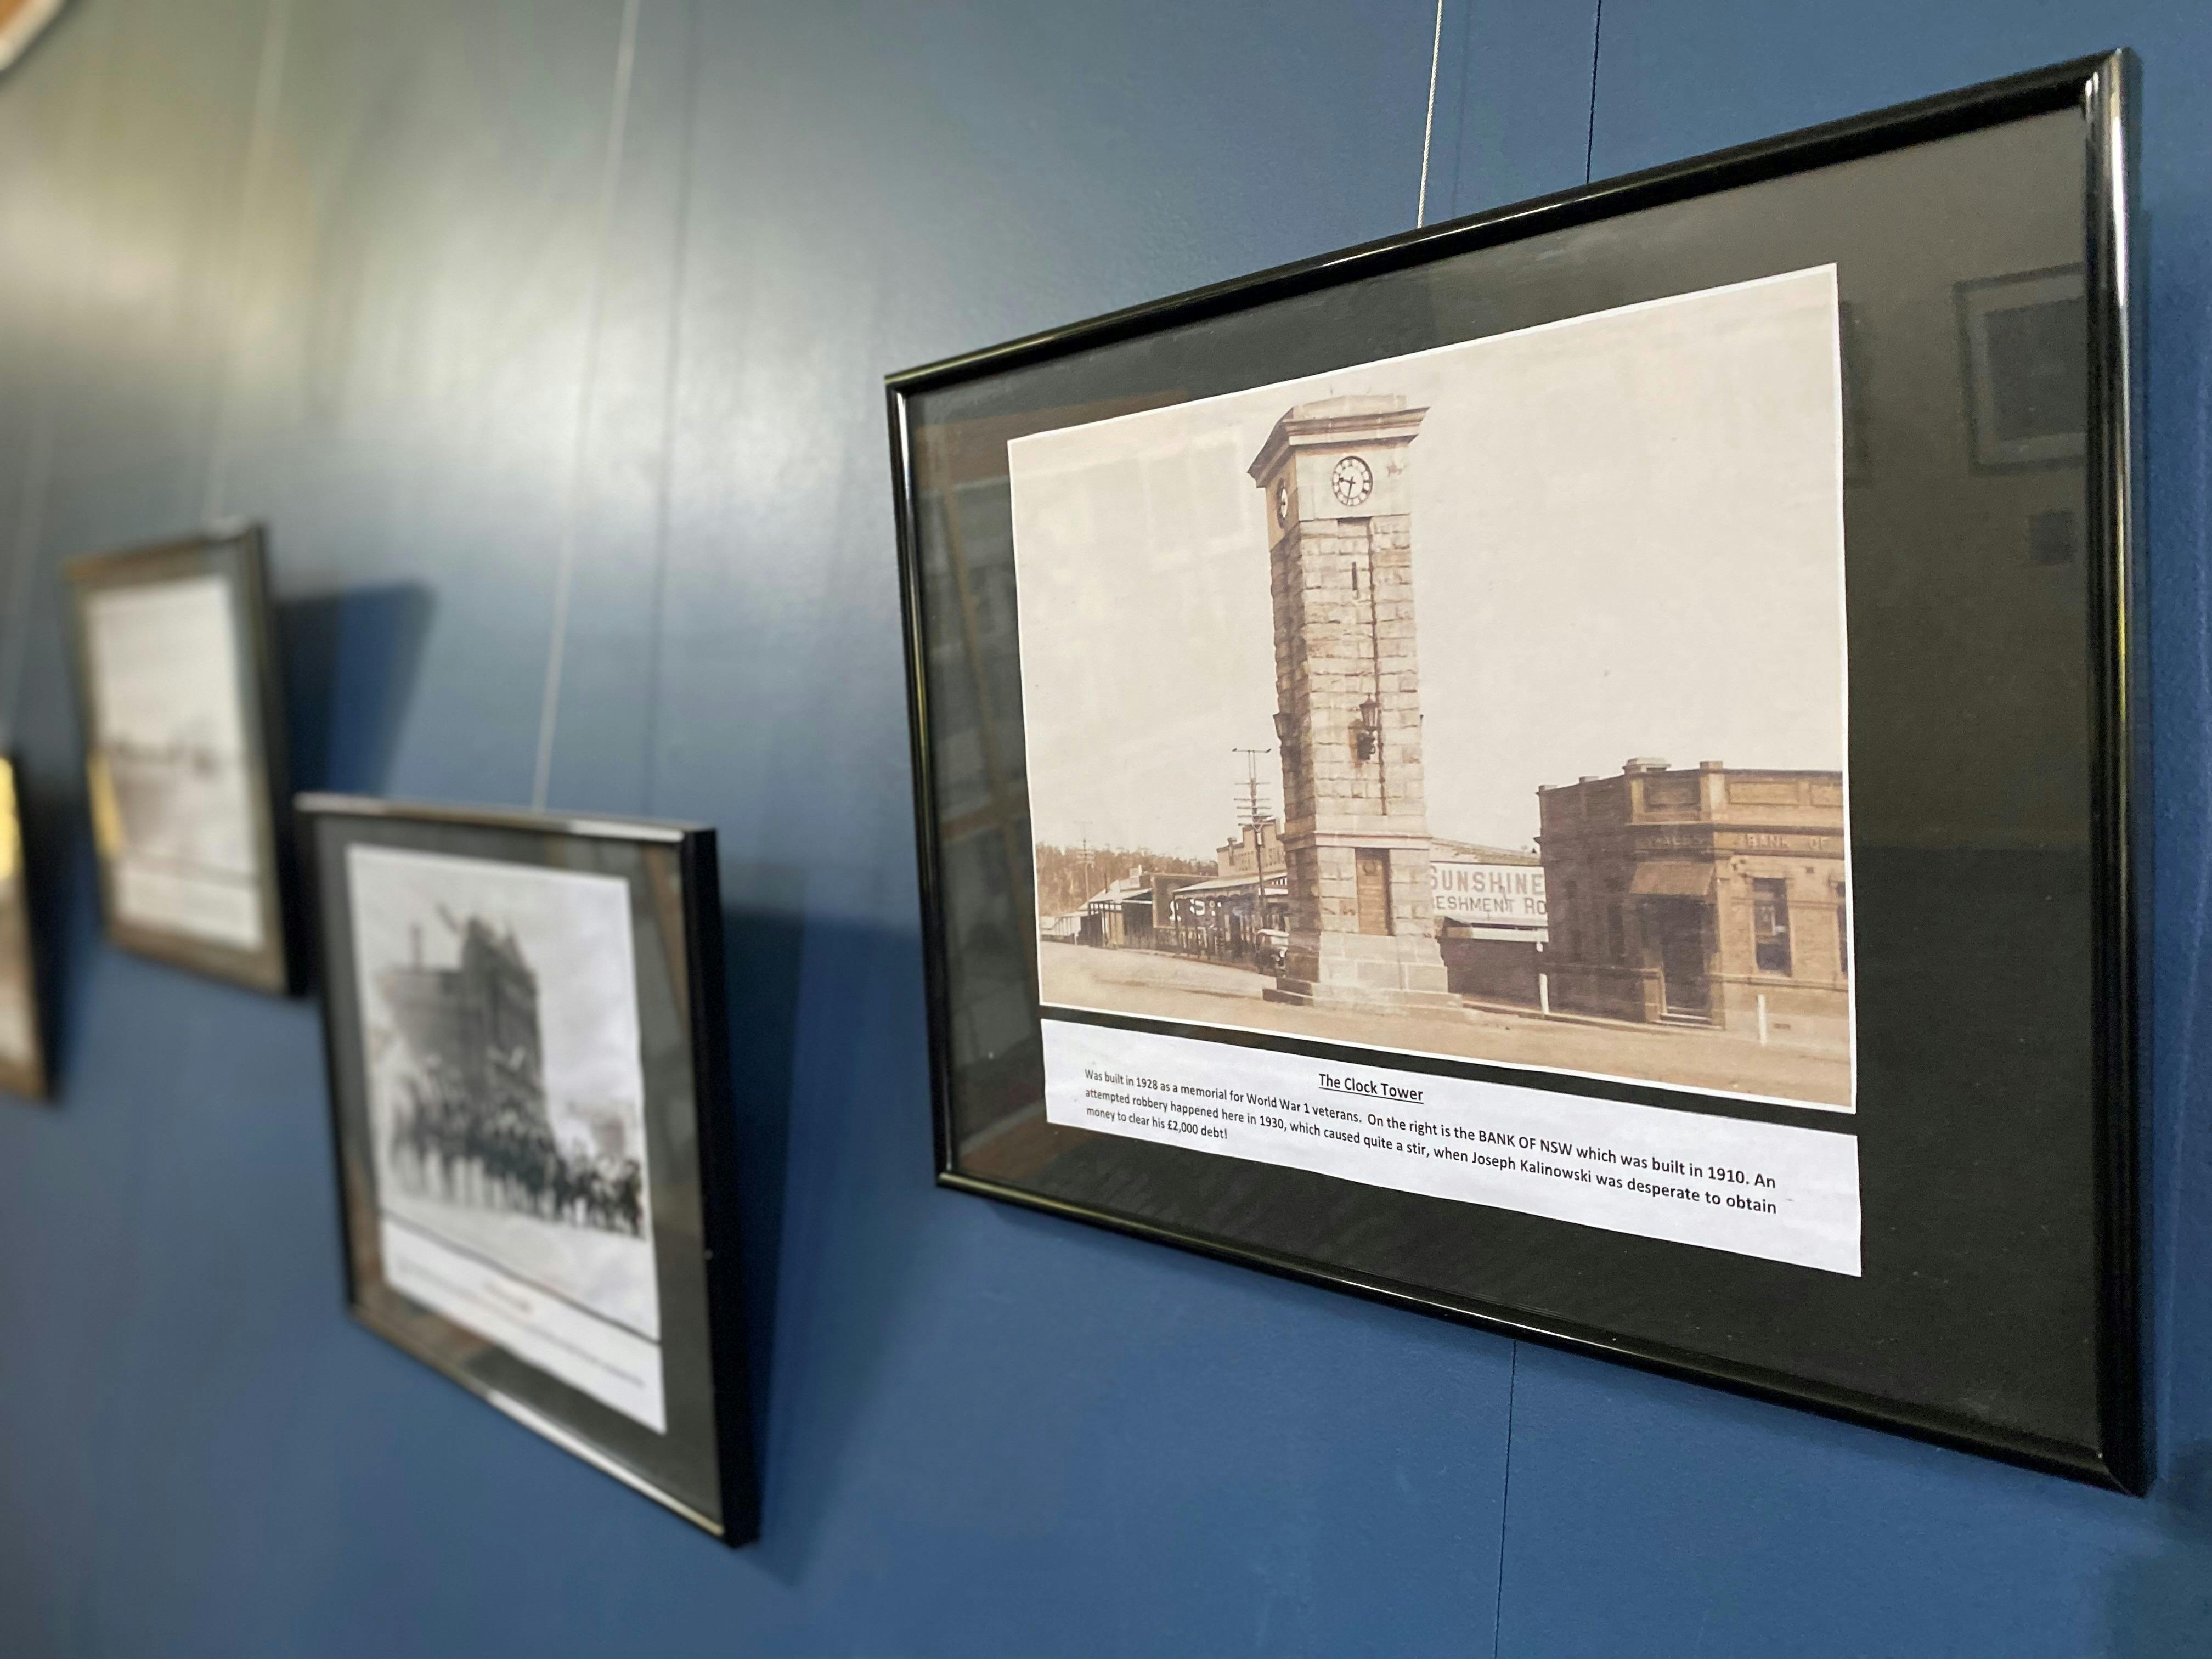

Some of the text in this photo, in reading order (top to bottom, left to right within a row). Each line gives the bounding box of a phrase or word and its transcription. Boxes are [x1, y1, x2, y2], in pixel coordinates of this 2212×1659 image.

[1429, 865, 1545, 895] SUNSHINE
[1432, 895, 1515, 913] ESHMENT
[1318, 1073, 1424, 1101] The Clock Tower
[1085, 1069, 1776, 1189] Was built in 1928 as a memorial for World War 1 veterans. On the right is the BANK OF NSW which was built in 1910. An
[1087, 1108, 1227, 1139] money to clear his £2,000 debt!
[1086, 1090, 1776, 1214] attempted robbery happened here in 1930, which caused quite a stir, when Joseph Kalinowski was desperate to obtain
